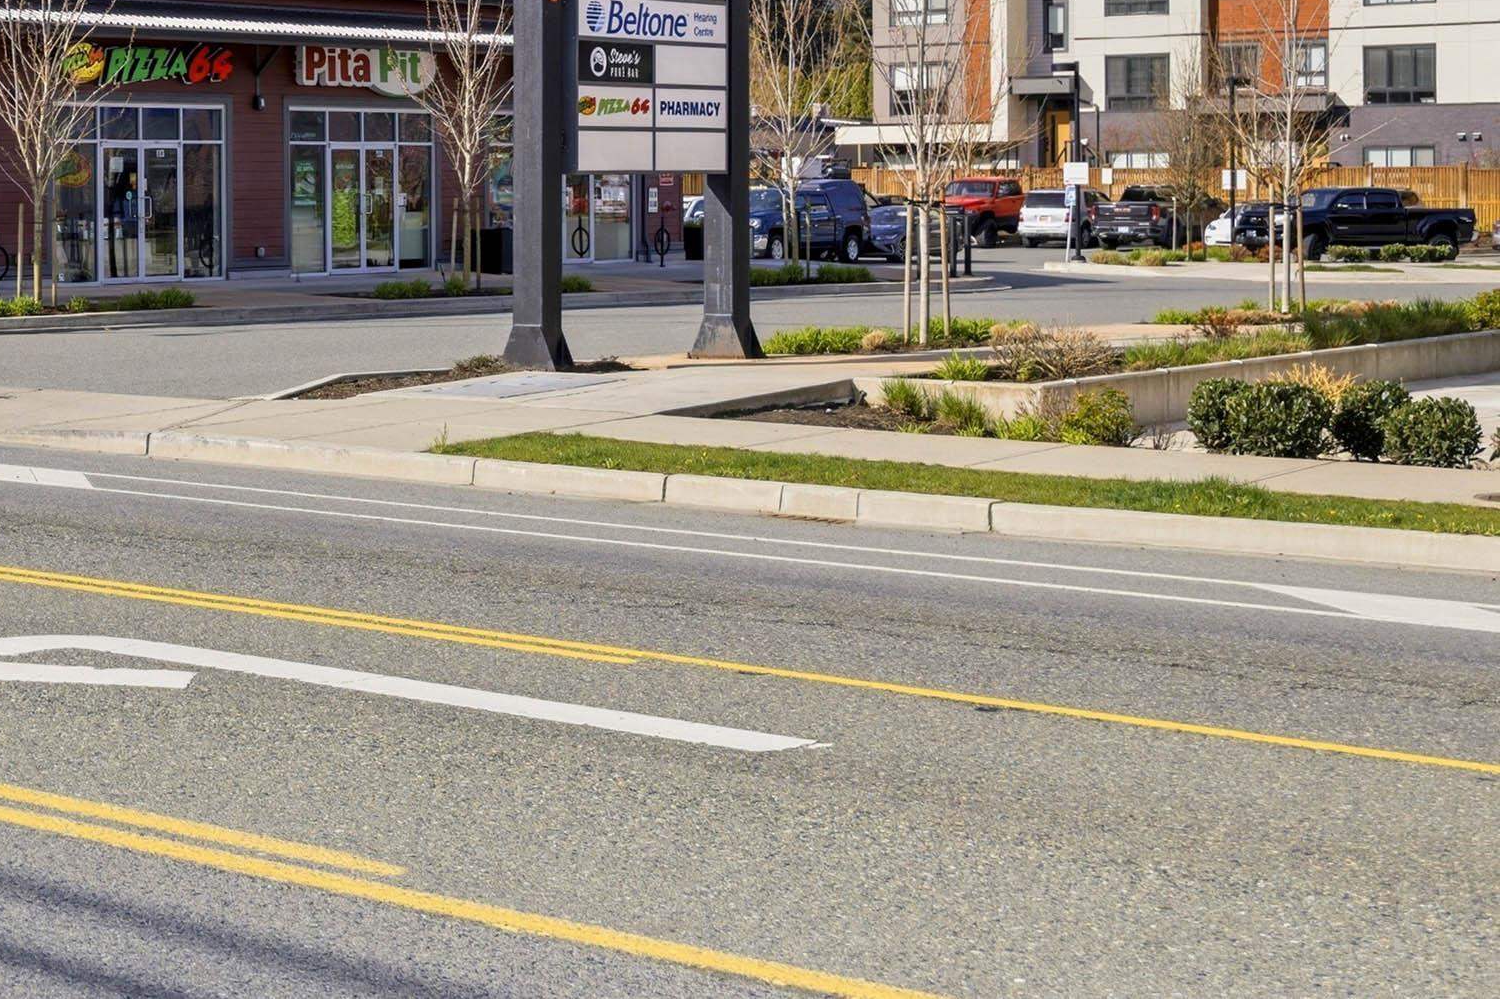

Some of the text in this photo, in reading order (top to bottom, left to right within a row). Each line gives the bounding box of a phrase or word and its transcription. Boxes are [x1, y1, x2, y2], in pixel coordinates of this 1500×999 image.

[606, 0, 688, 38] Beltone
[693, 11, 717, 24] Hearing
[105, 46, 188, 83] PIZZA
[188, 45, 233, 83] 64
[305, 46, 371, 82] Pita
[596, 97, 630, 116] PIZZA
[660, 101, 721, 117] PHARMACY
